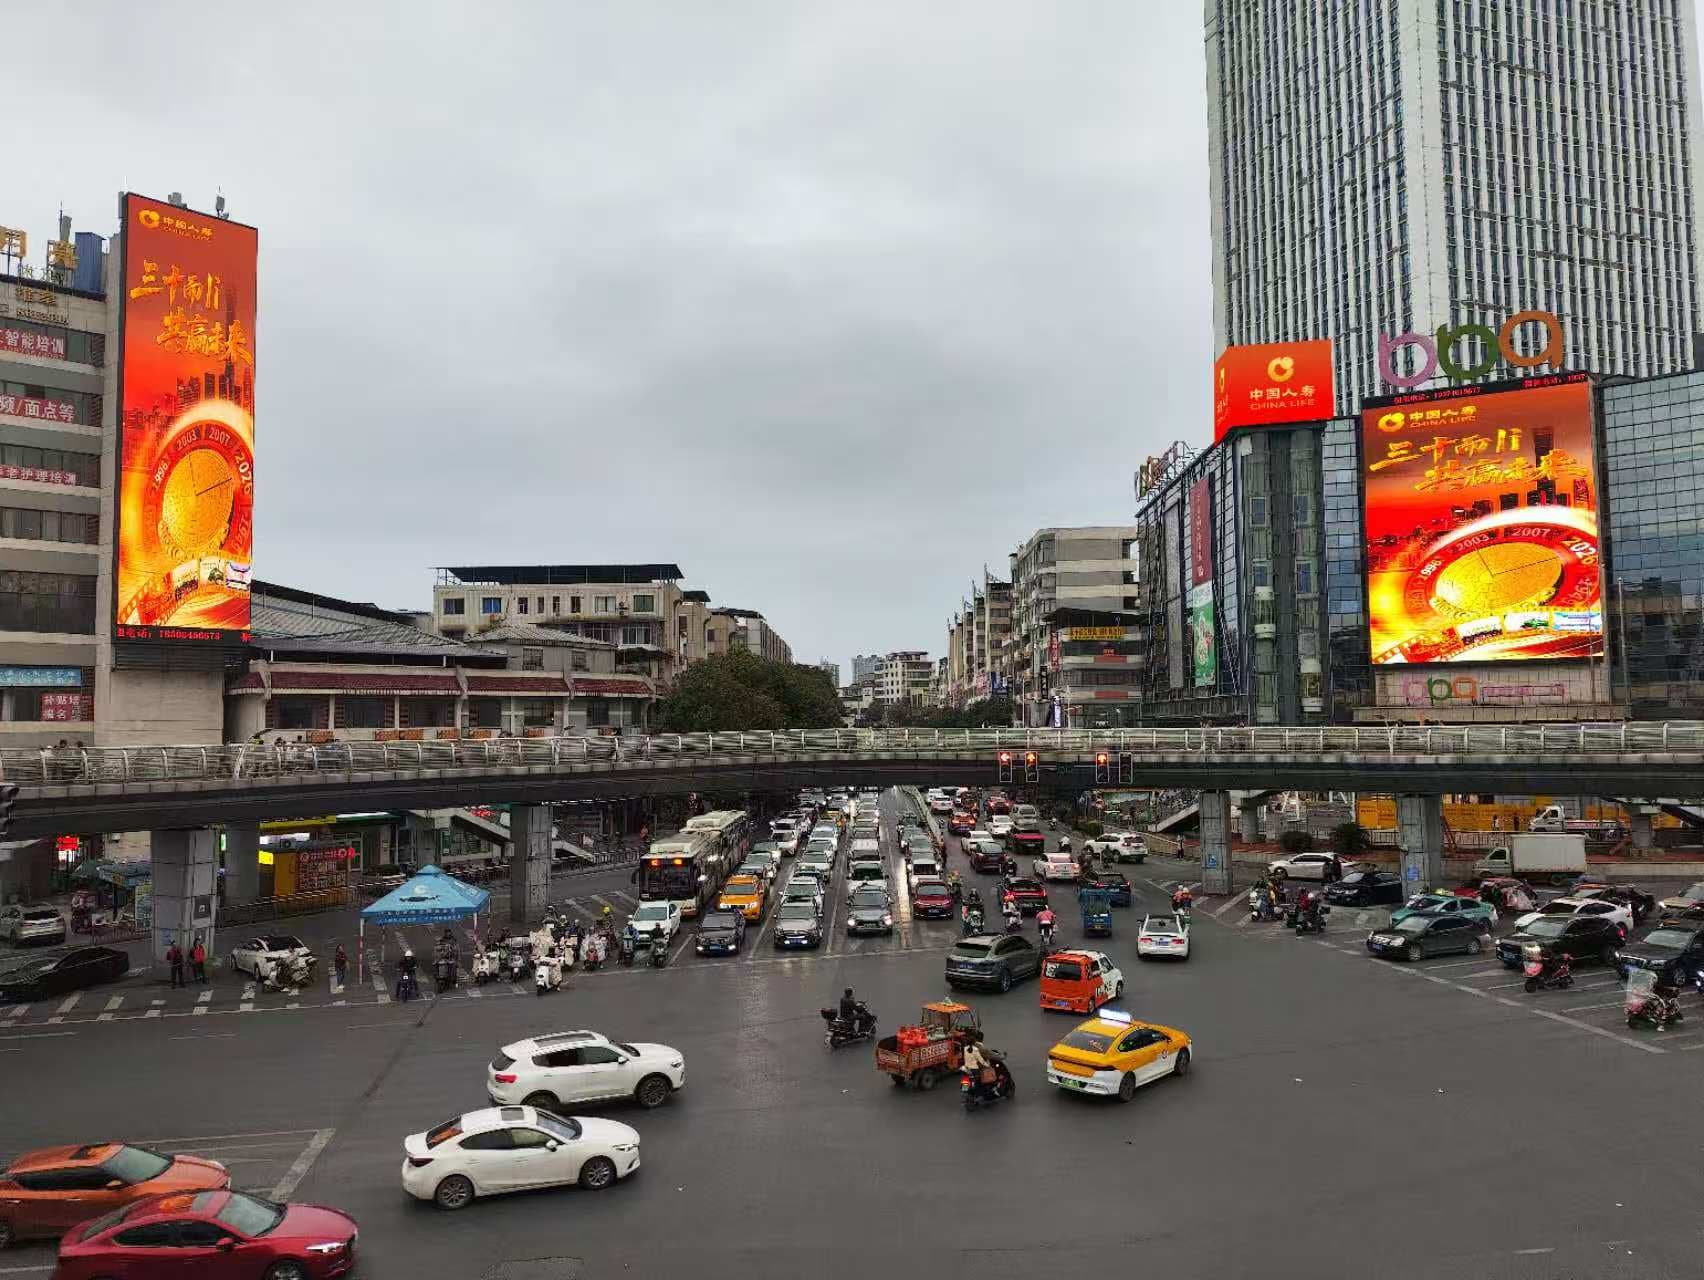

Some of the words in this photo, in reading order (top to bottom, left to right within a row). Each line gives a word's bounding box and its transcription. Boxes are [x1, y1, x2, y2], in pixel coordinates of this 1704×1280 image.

[163, 216, 213, 237] 中国人寿
[1249, 385, 1316, 400] 中国人寿
[1250, 401, 1287, 410] CHINA
[1290, 399, 1315, 407] LIFE
[1409, 405, 1477, 421] 中国人寿
[1410, 418, 1447, 428] CHINA
[176, 430, 198, 450] 2003
[208, 426, 231, 445] 2007
[1512, 527, 1551, 538] 2007
[1456, 533, 1490, 552] 2003
